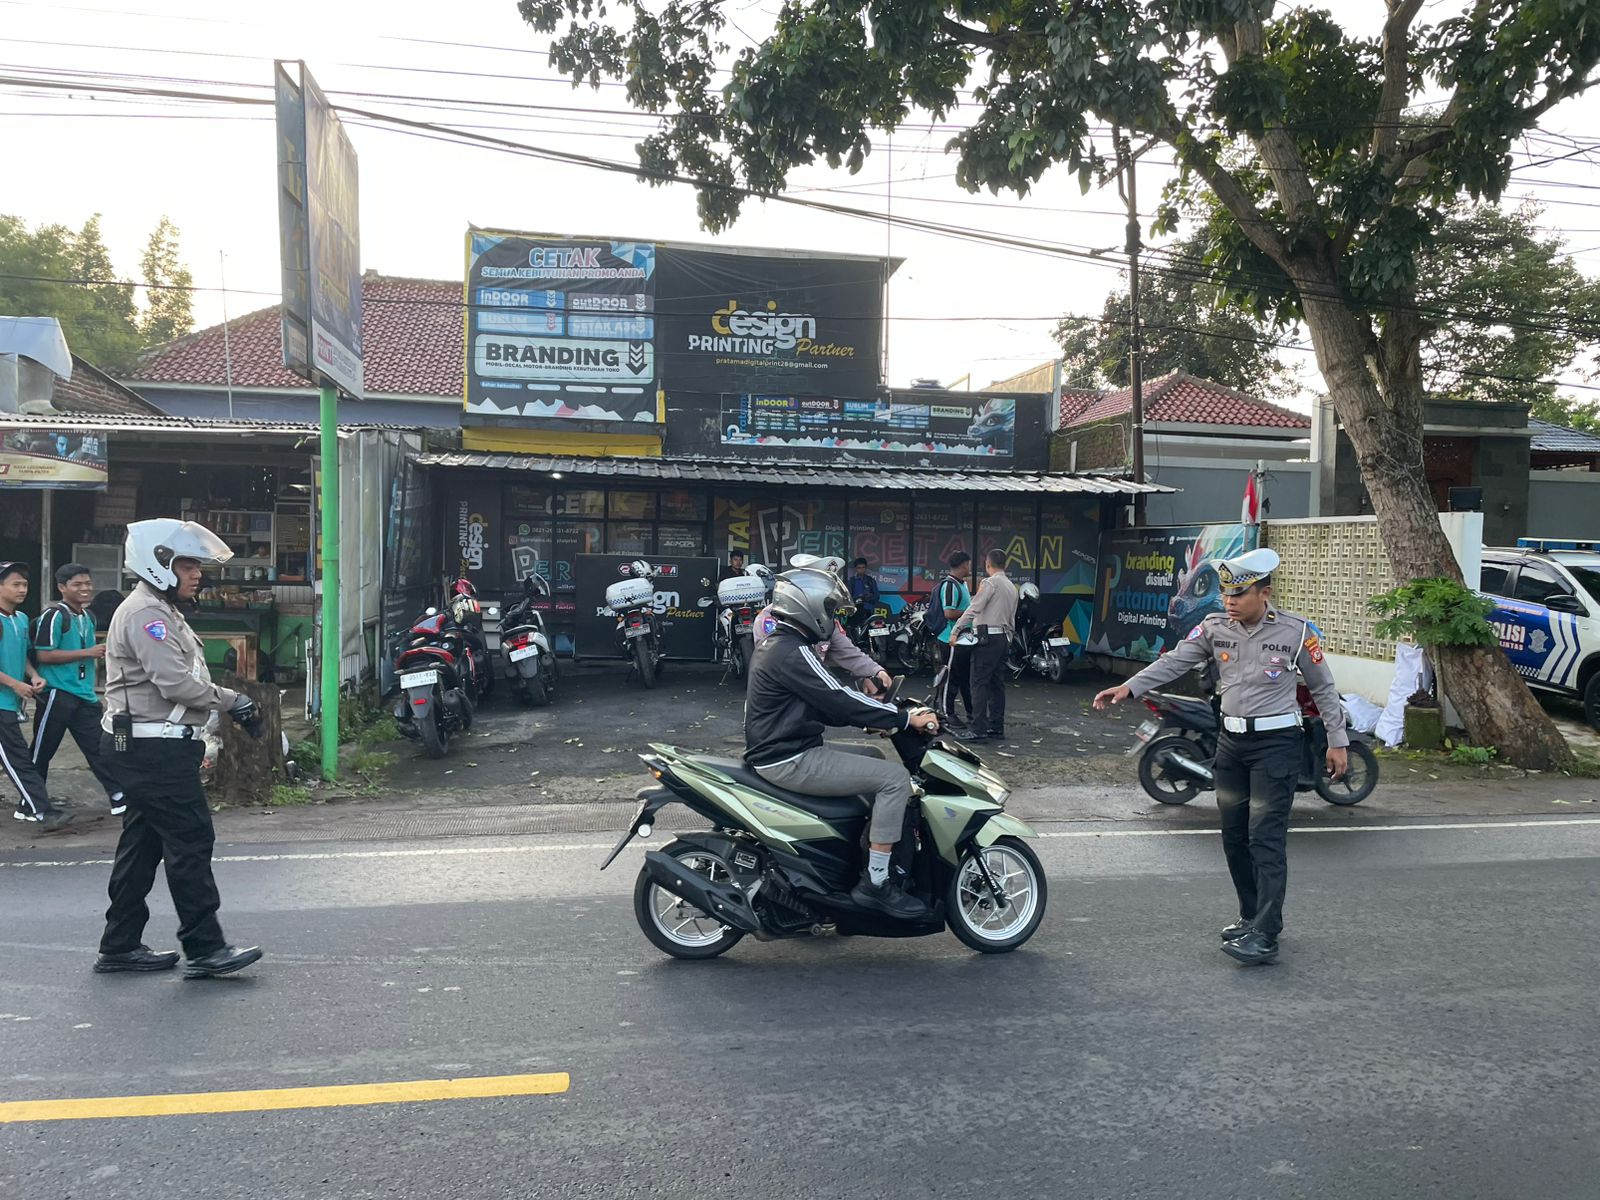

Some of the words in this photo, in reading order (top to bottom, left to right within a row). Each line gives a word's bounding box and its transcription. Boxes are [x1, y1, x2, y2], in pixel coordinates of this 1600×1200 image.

[529, 247, 602, 268] CETAK
[481, 266, 518, 279] SEMUA
[518, 267, 581, 279] KEBUTUHAN
[581, 267, 618, 279] PROMO
[618, 267, 646, 279] ANDA
[481, 290, 529, 302] inDOOR
[572, 297, 628, 308] outDOOR
[711, 299, 817, 349] design
[688, 334, 776, 354] PRINTING
[795, 338, 856, 357] Partner
[485, 342, 620, 367] BRANDING
[756, 399, 788, 407] inDOOR
[932, 407, 965, 415] BRANDING
[458, 501, 469, 547] PRINTING
[462, 512, 489, 570] design
[1125, 551, 1175, 574] branding
[1145, 572, 1174, 586] disini!!
[665, 606, 705, 618] Partner
[1118, 612, 1139, 625] Digital
[1139, 614, 1167, 629] Printing
[1262, 643, 1292, 653] POLRI
